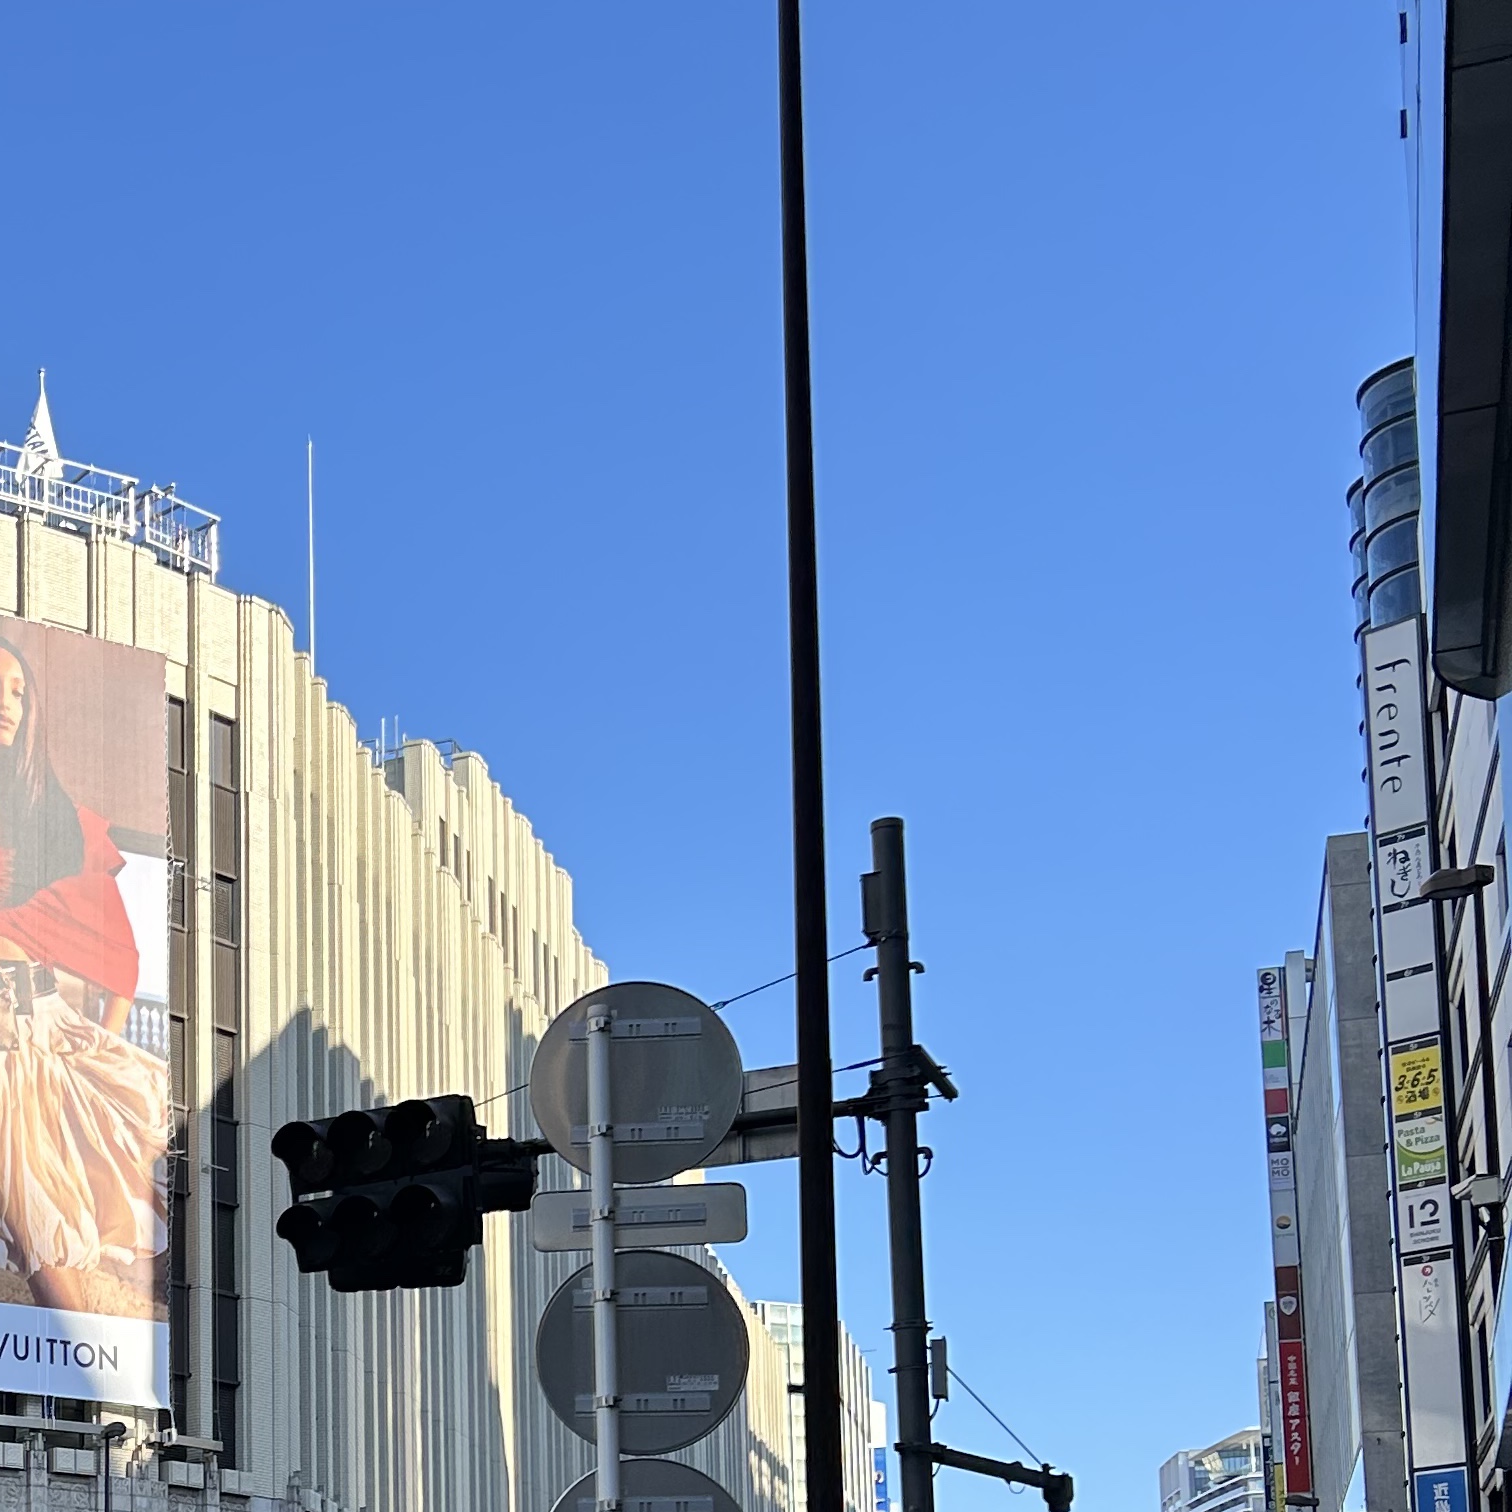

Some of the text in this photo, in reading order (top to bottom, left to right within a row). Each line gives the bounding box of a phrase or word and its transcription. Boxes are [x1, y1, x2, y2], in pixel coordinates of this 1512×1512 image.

[1386, 846, 1412, 898] ねぎし
[1397, 1125, 1426, 1139] Pasta
[1405, 1133, 1441, 1148] & Pizza
[1408, 1198, 1440, 1229] 12
